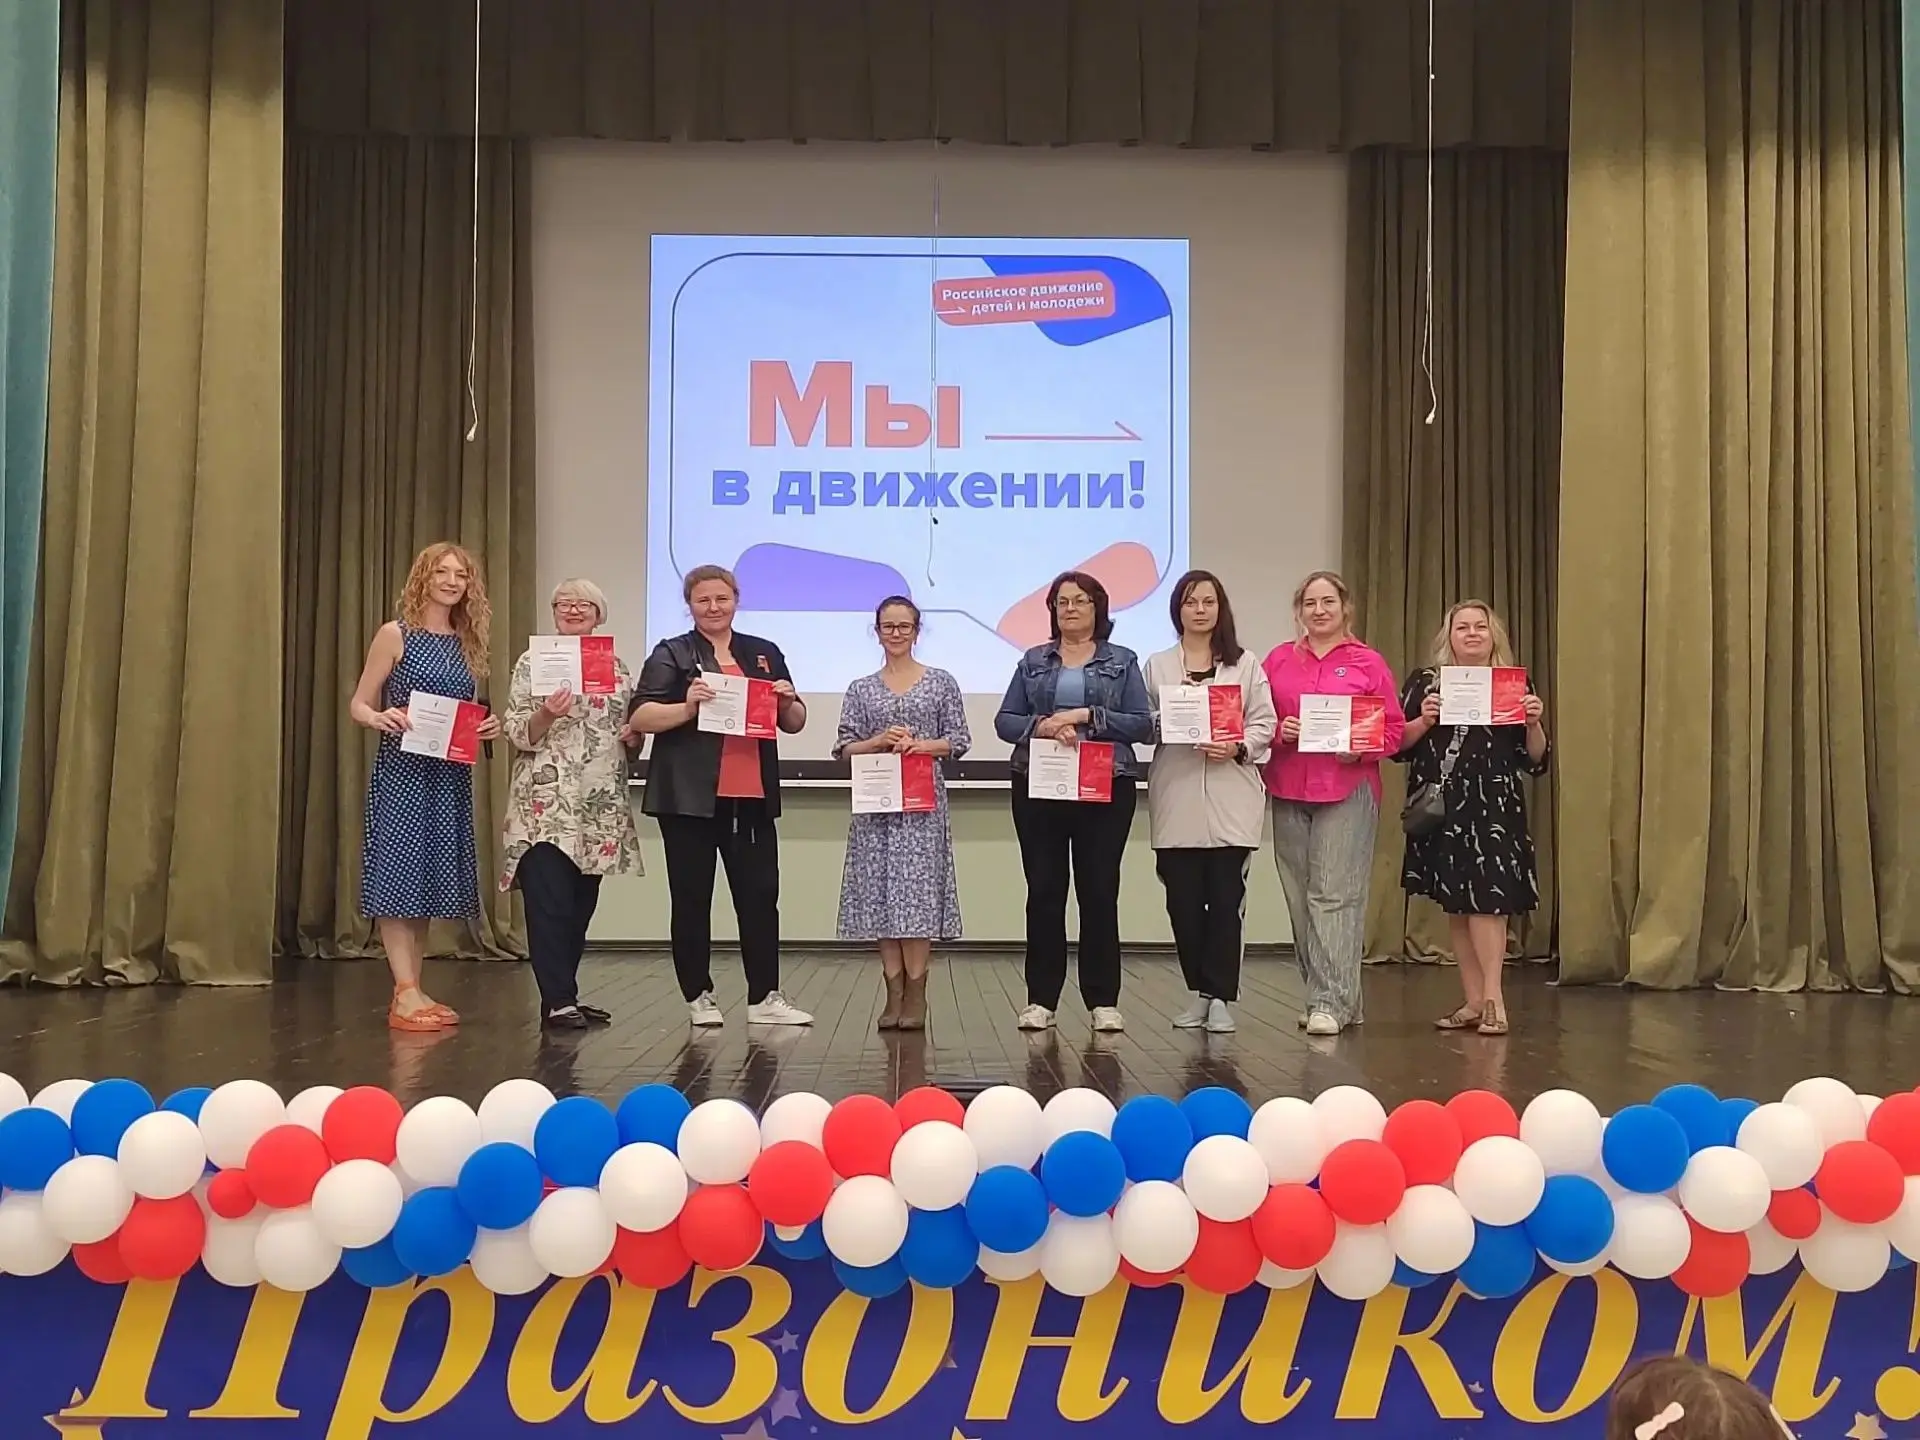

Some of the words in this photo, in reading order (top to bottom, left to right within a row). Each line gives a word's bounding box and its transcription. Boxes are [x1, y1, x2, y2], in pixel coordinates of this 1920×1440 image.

[942, 286, 1026, 301] Российское
[1030, 282, 1104, 297] движение
[971, 300, 1013, 315] детей
[1017, 300, 1026, 311] и
[1030, 296, 1105, 310] молодежи
[749, 360, 961, 448] Мы
[712, 470, 750, 505] в
[772, 460, 1145, 515] движении!
